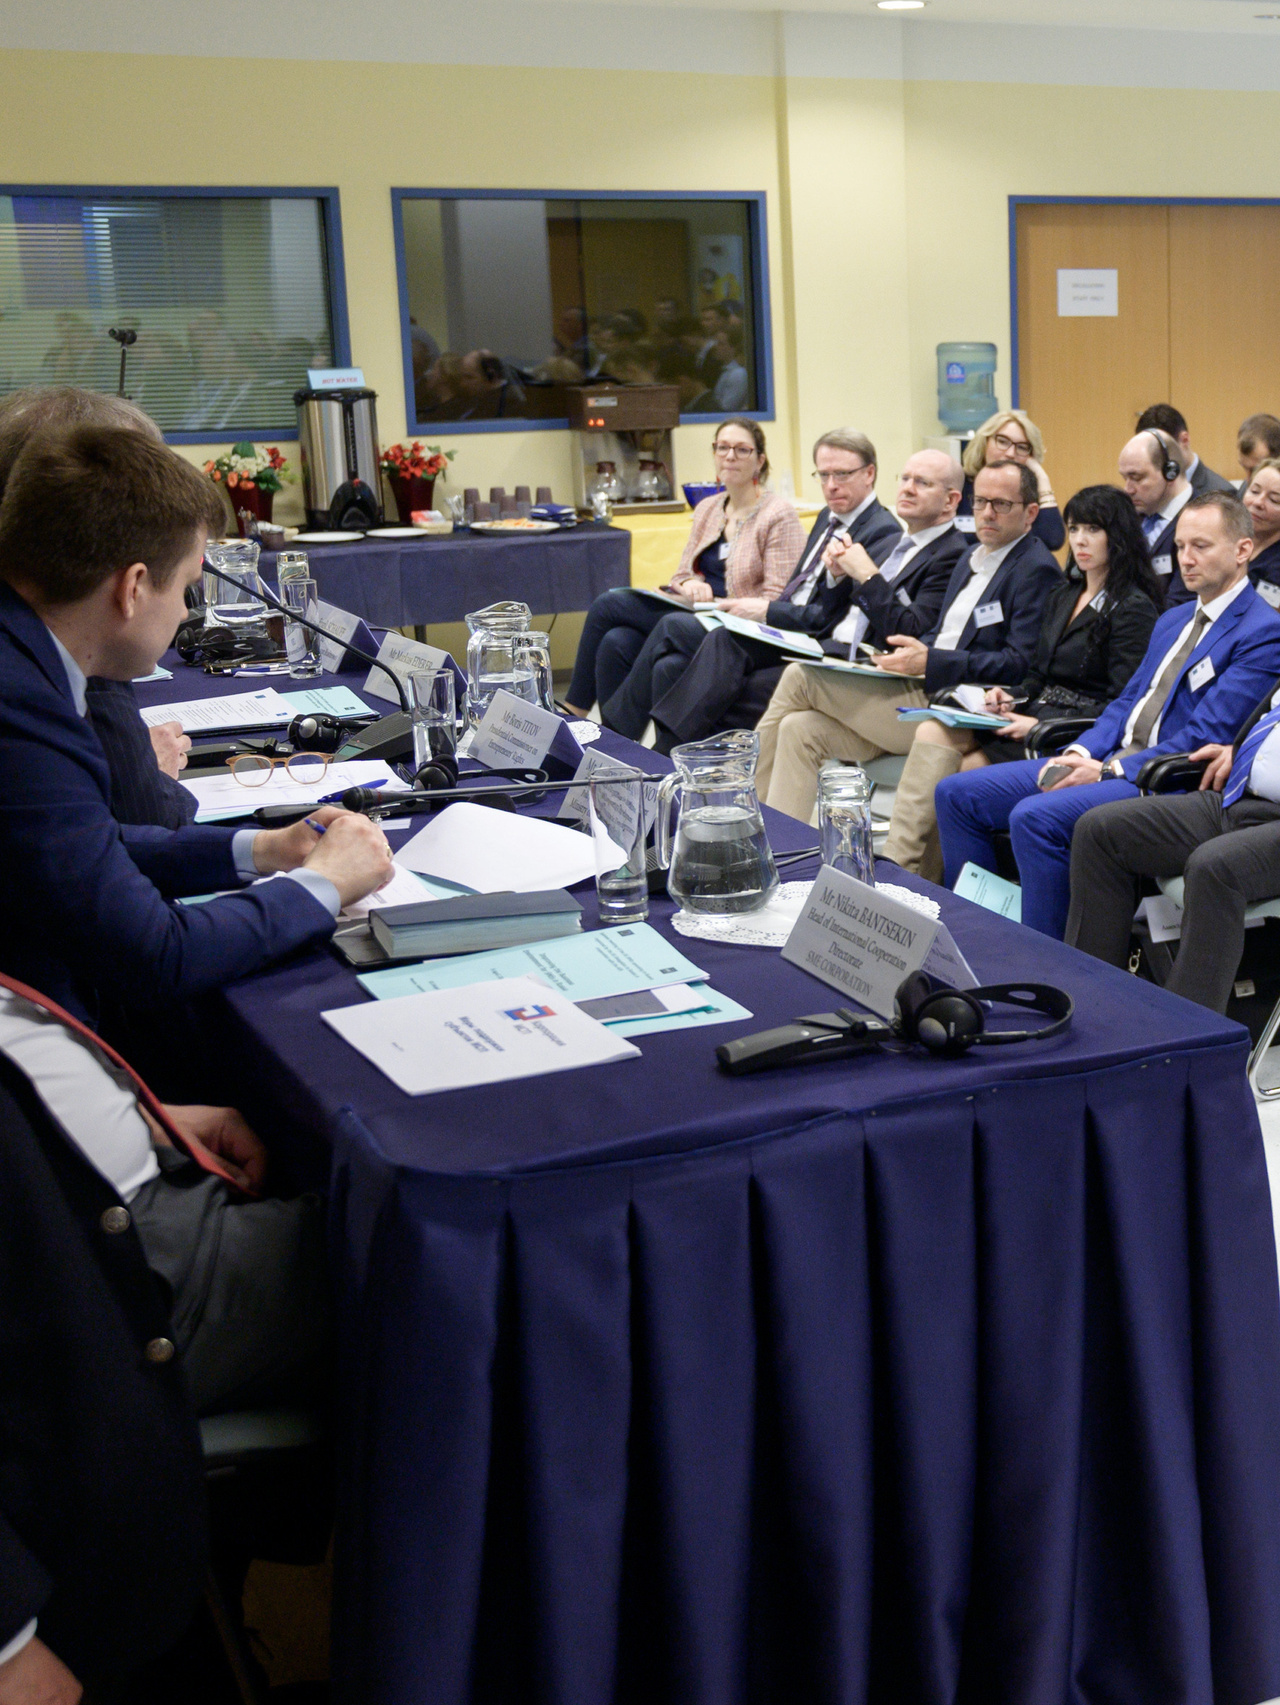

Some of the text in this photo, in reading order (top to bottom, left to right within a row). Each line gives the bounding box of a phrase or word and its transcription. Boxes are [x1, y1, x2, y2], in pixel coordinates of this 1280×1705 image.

[335, 376, 358, 384] WATER
[502, 710, 541, 737] Mr Boris TITOV
[819, 886, 917, 949] Mr Nikita BANTSEKIN
[807, 906, 908, 972] Head of International Cooperation
[828, 941, 864, 970] Directorate
[805, 950, 873, 997] SME CORPORATION
